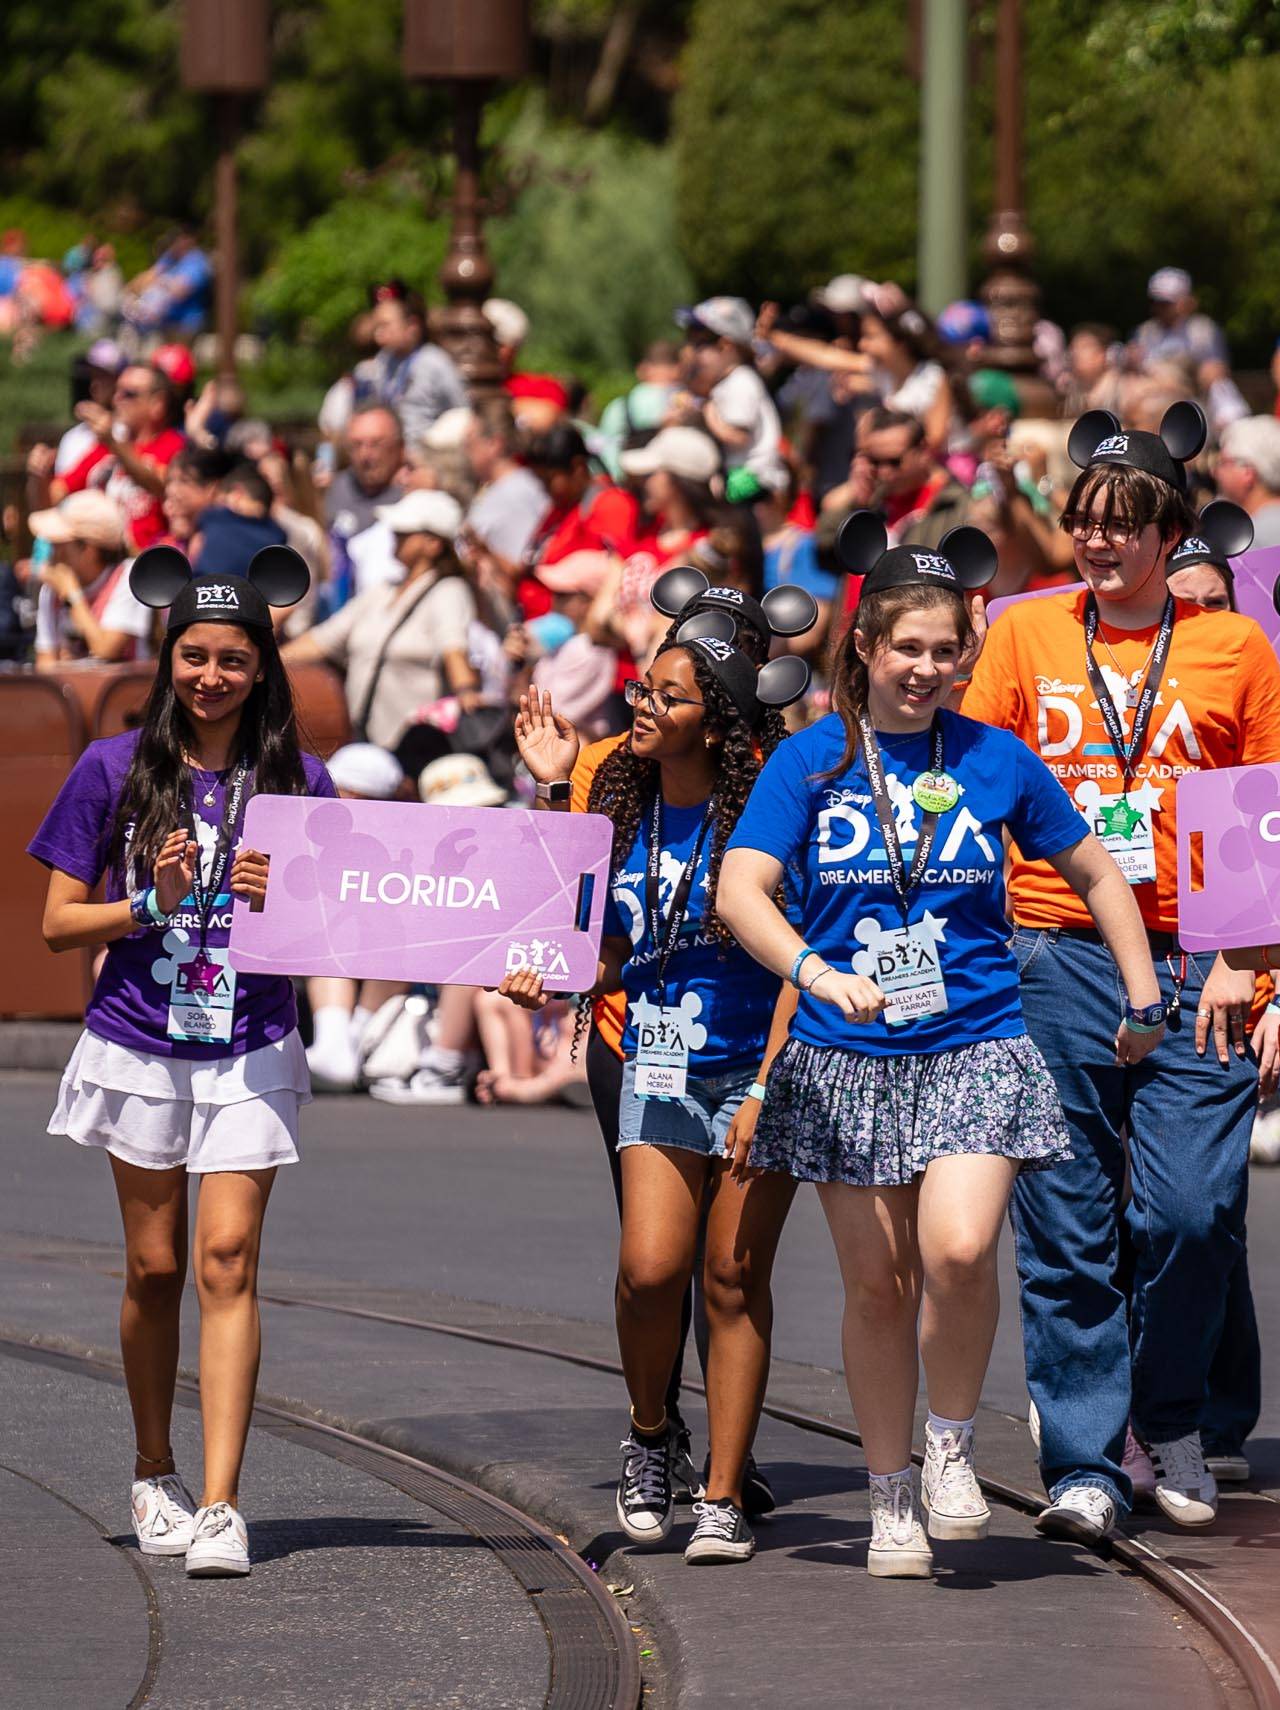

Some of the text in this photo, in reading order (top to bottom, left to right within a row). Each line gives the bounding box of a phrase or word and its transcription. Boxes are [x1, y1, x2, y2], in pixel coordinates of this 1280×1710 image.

[1051, 763, 1118, 779] REAMERS
[339, 870, 501, 911] FLORIDA
[915, 989, 938, 1001] KATE
[900, 1000, 932, 1012] FARRAR
[648, 1072, 673, 1080] ALANA
[647, 1081, 673, 1089] MCBEAN
